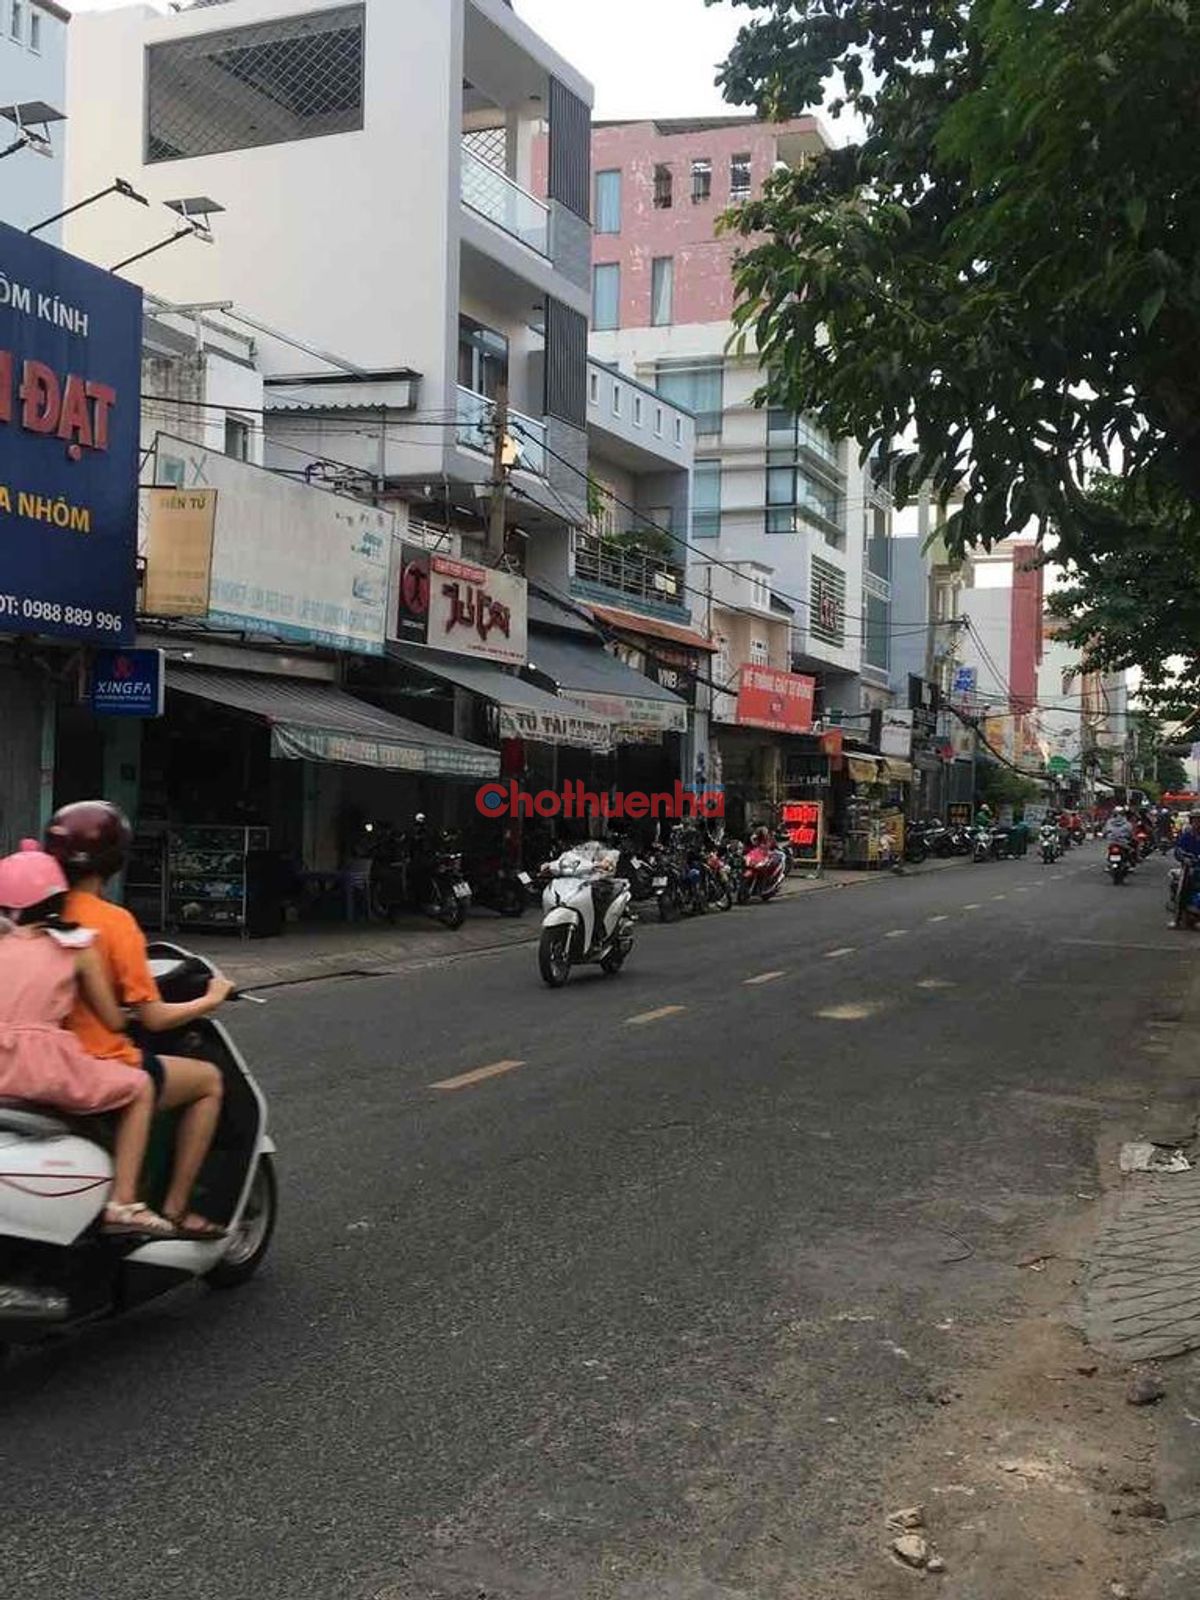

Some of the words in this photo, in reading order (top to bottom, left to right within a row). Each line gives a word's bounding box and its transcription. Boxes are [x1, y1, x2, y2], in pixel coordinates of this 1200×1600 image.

[37, 293, 89, 336] KÍNH
[20, 359, 116, 461] ĐẠT
[23, 599, 62, 622] 0988
[65, 605, 92, 624] 889
[97, 612, 122, 632] 996
[96, 681, 151, 694] XINGFA
